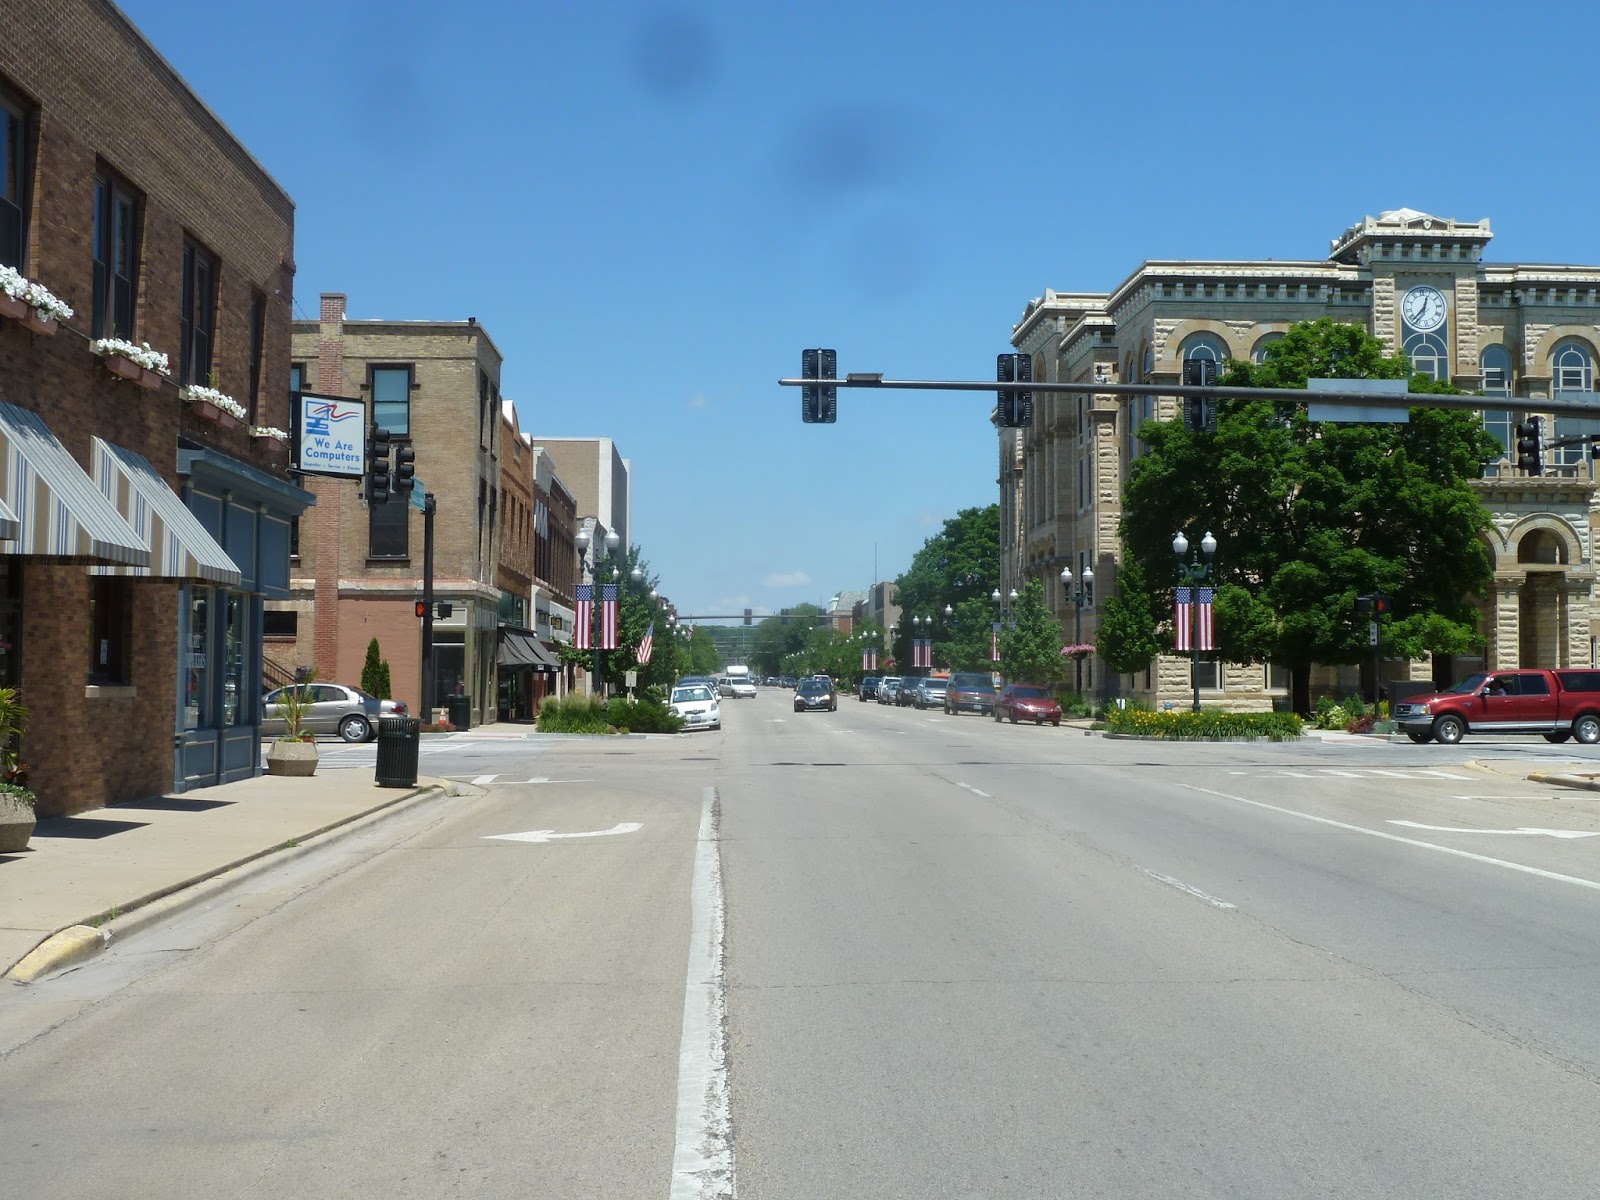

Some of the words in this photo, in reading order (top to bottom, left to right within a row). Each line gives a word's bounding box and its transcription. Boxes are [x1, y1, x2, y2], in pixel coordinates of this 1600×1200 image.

[314, 438, 330, 448] We
[335, 440, 353, 450] Are
[306, 448, 360, 461] Computers
